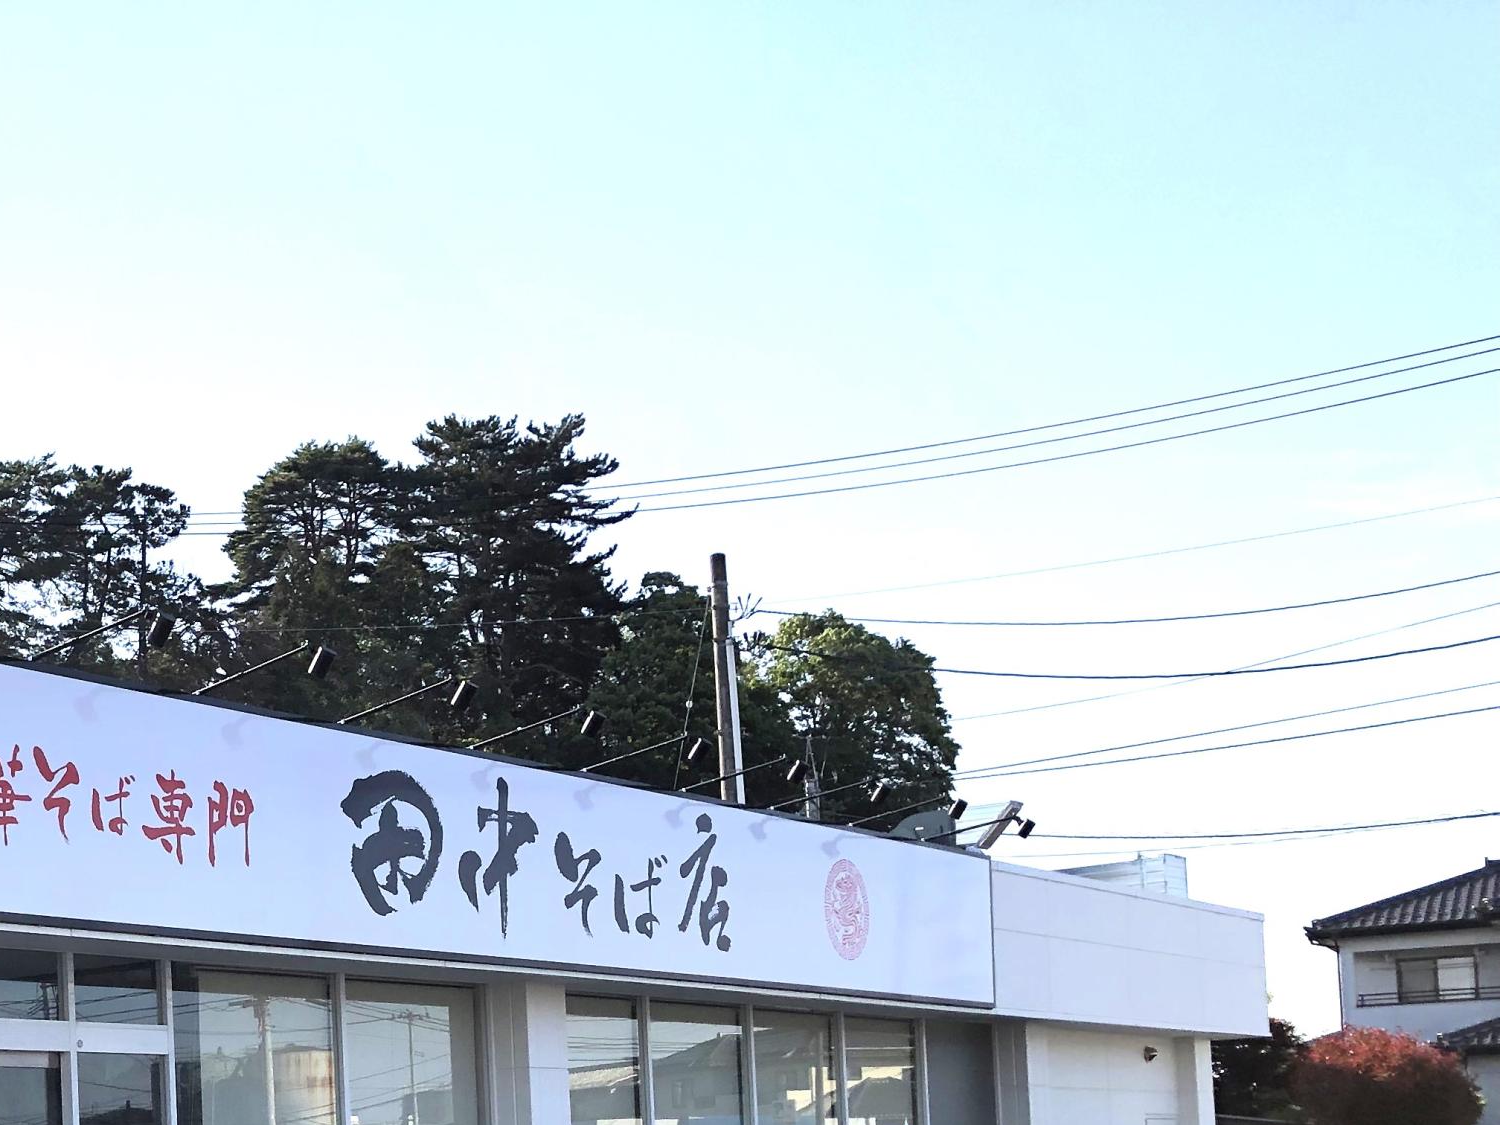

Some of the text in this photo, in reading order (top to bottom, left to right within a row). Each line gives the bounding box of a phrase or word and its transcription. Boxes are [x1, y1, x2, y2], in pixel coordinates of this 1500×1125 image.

[339, 769, 732, 953] 田中そば店
